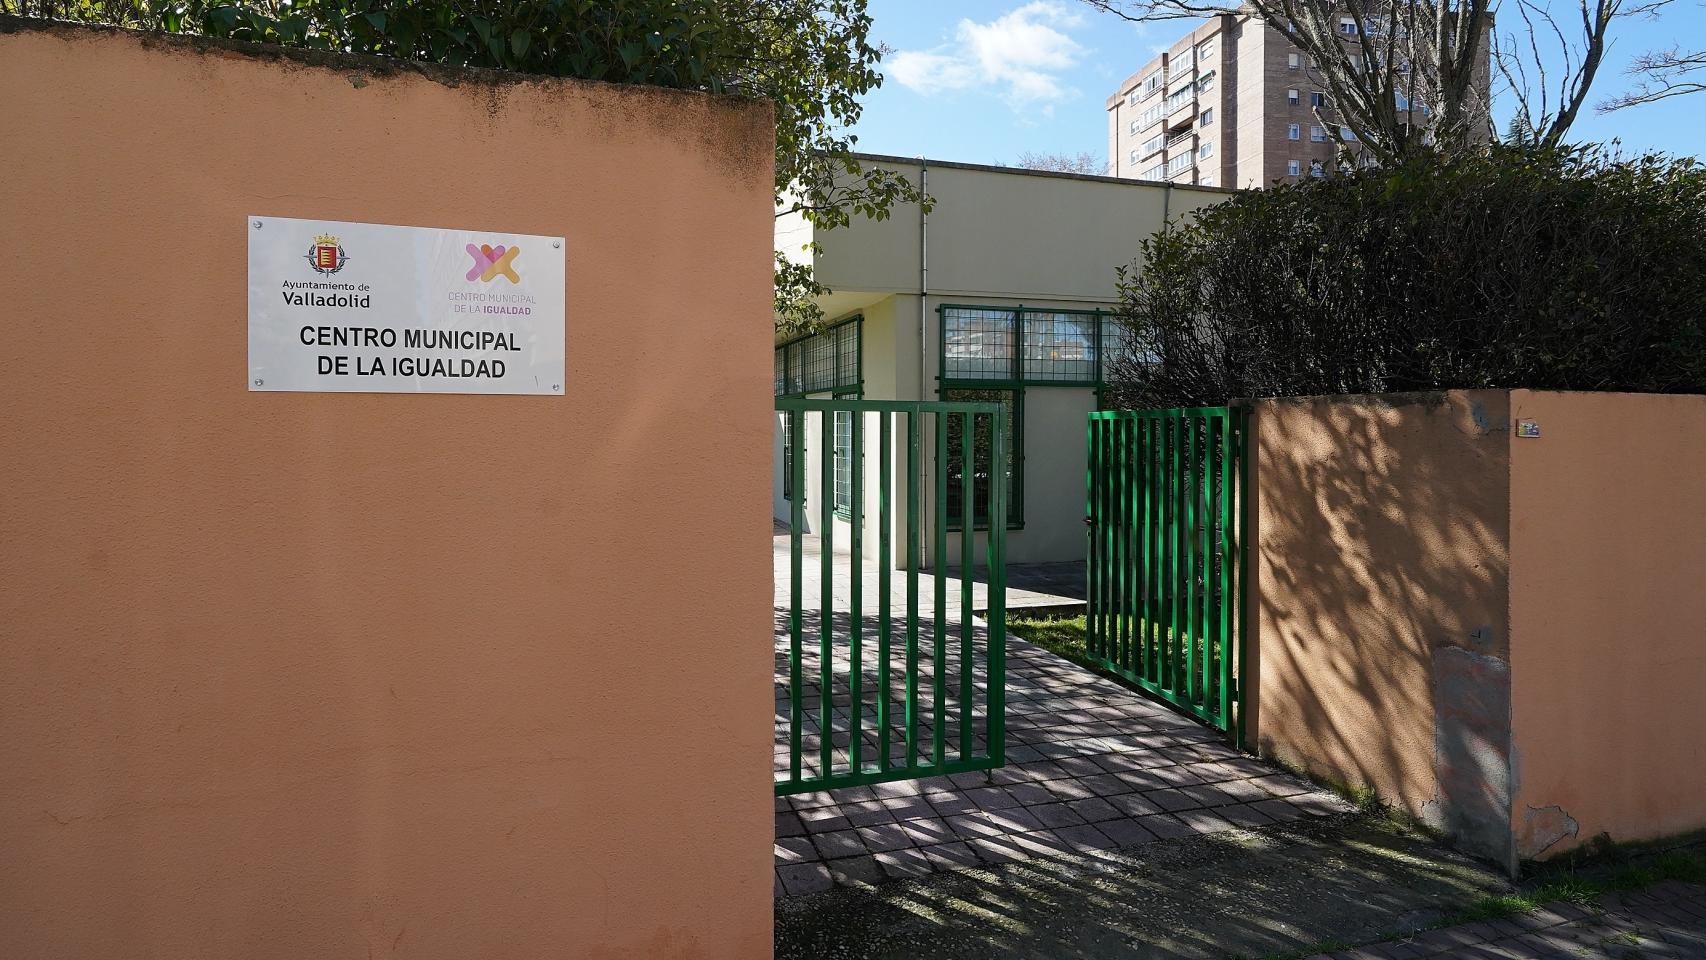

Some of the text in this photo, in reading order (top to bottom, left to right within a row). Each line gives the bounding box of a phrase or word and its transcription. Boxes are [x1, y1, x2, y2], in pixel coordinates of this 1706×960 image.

[282, 280, 370, 292] Ayuntamiento de
[282, 292, 370, 309] Valladolid
[448, 292, 536, 304] CENTRO MUNICIPAL
[454, 304, 531, 315] DE LA IGUALDAD
[300, 326, 521, 351] CENTRO MUNICIPAL
[318, 356, 506, 378] DE LA IGUALDAD
